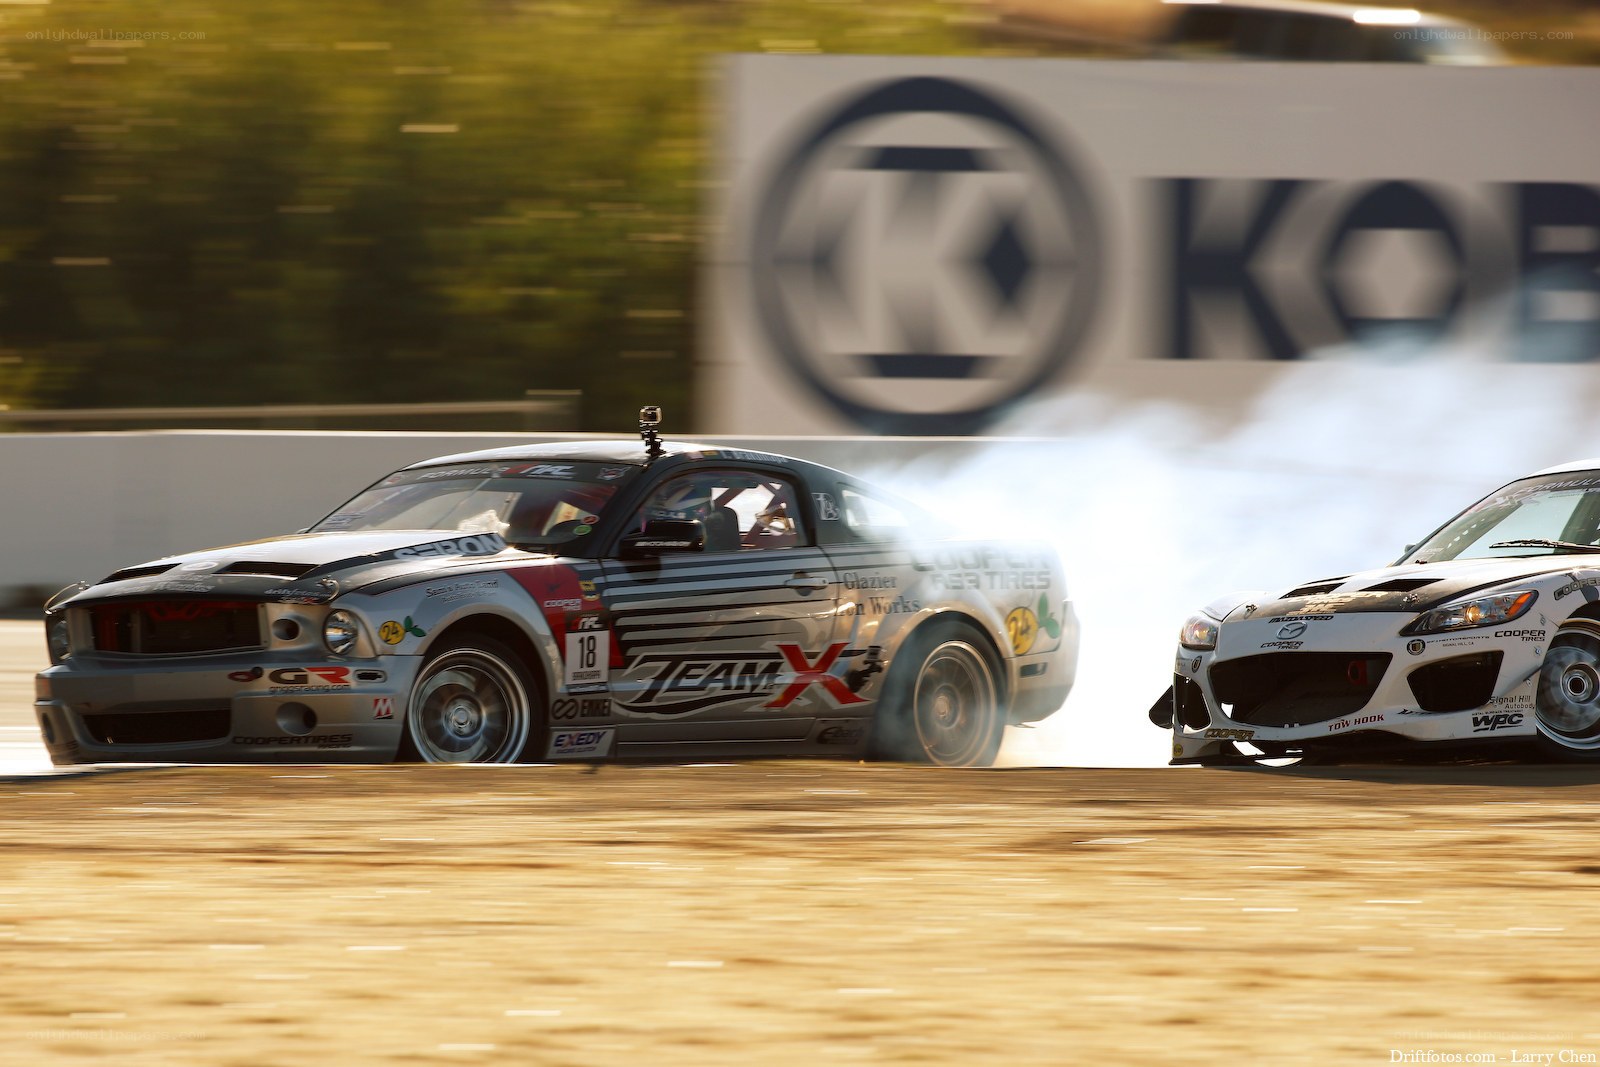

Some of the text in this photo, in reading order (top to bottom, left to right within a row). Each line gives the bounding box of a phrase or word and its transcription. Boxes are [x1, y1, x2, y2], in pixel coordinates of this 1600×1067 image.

[842, 571, 897, 590] Glazier
[983, 570, 1050, 590] TIRES
[869, 596, 921, 615] Works
[1495, 630, 1546, 638] COOPER
[578, 635, 597, 668] 18
[269, 666, 350, 685] GR
[629, 643, 873, 709] TEAM X
[1490, 695, 1531, 705] Signal Hill
[1328, 714, 1385, 731] TOW HOOK
[553, 731, 607, 747] EXEDY
